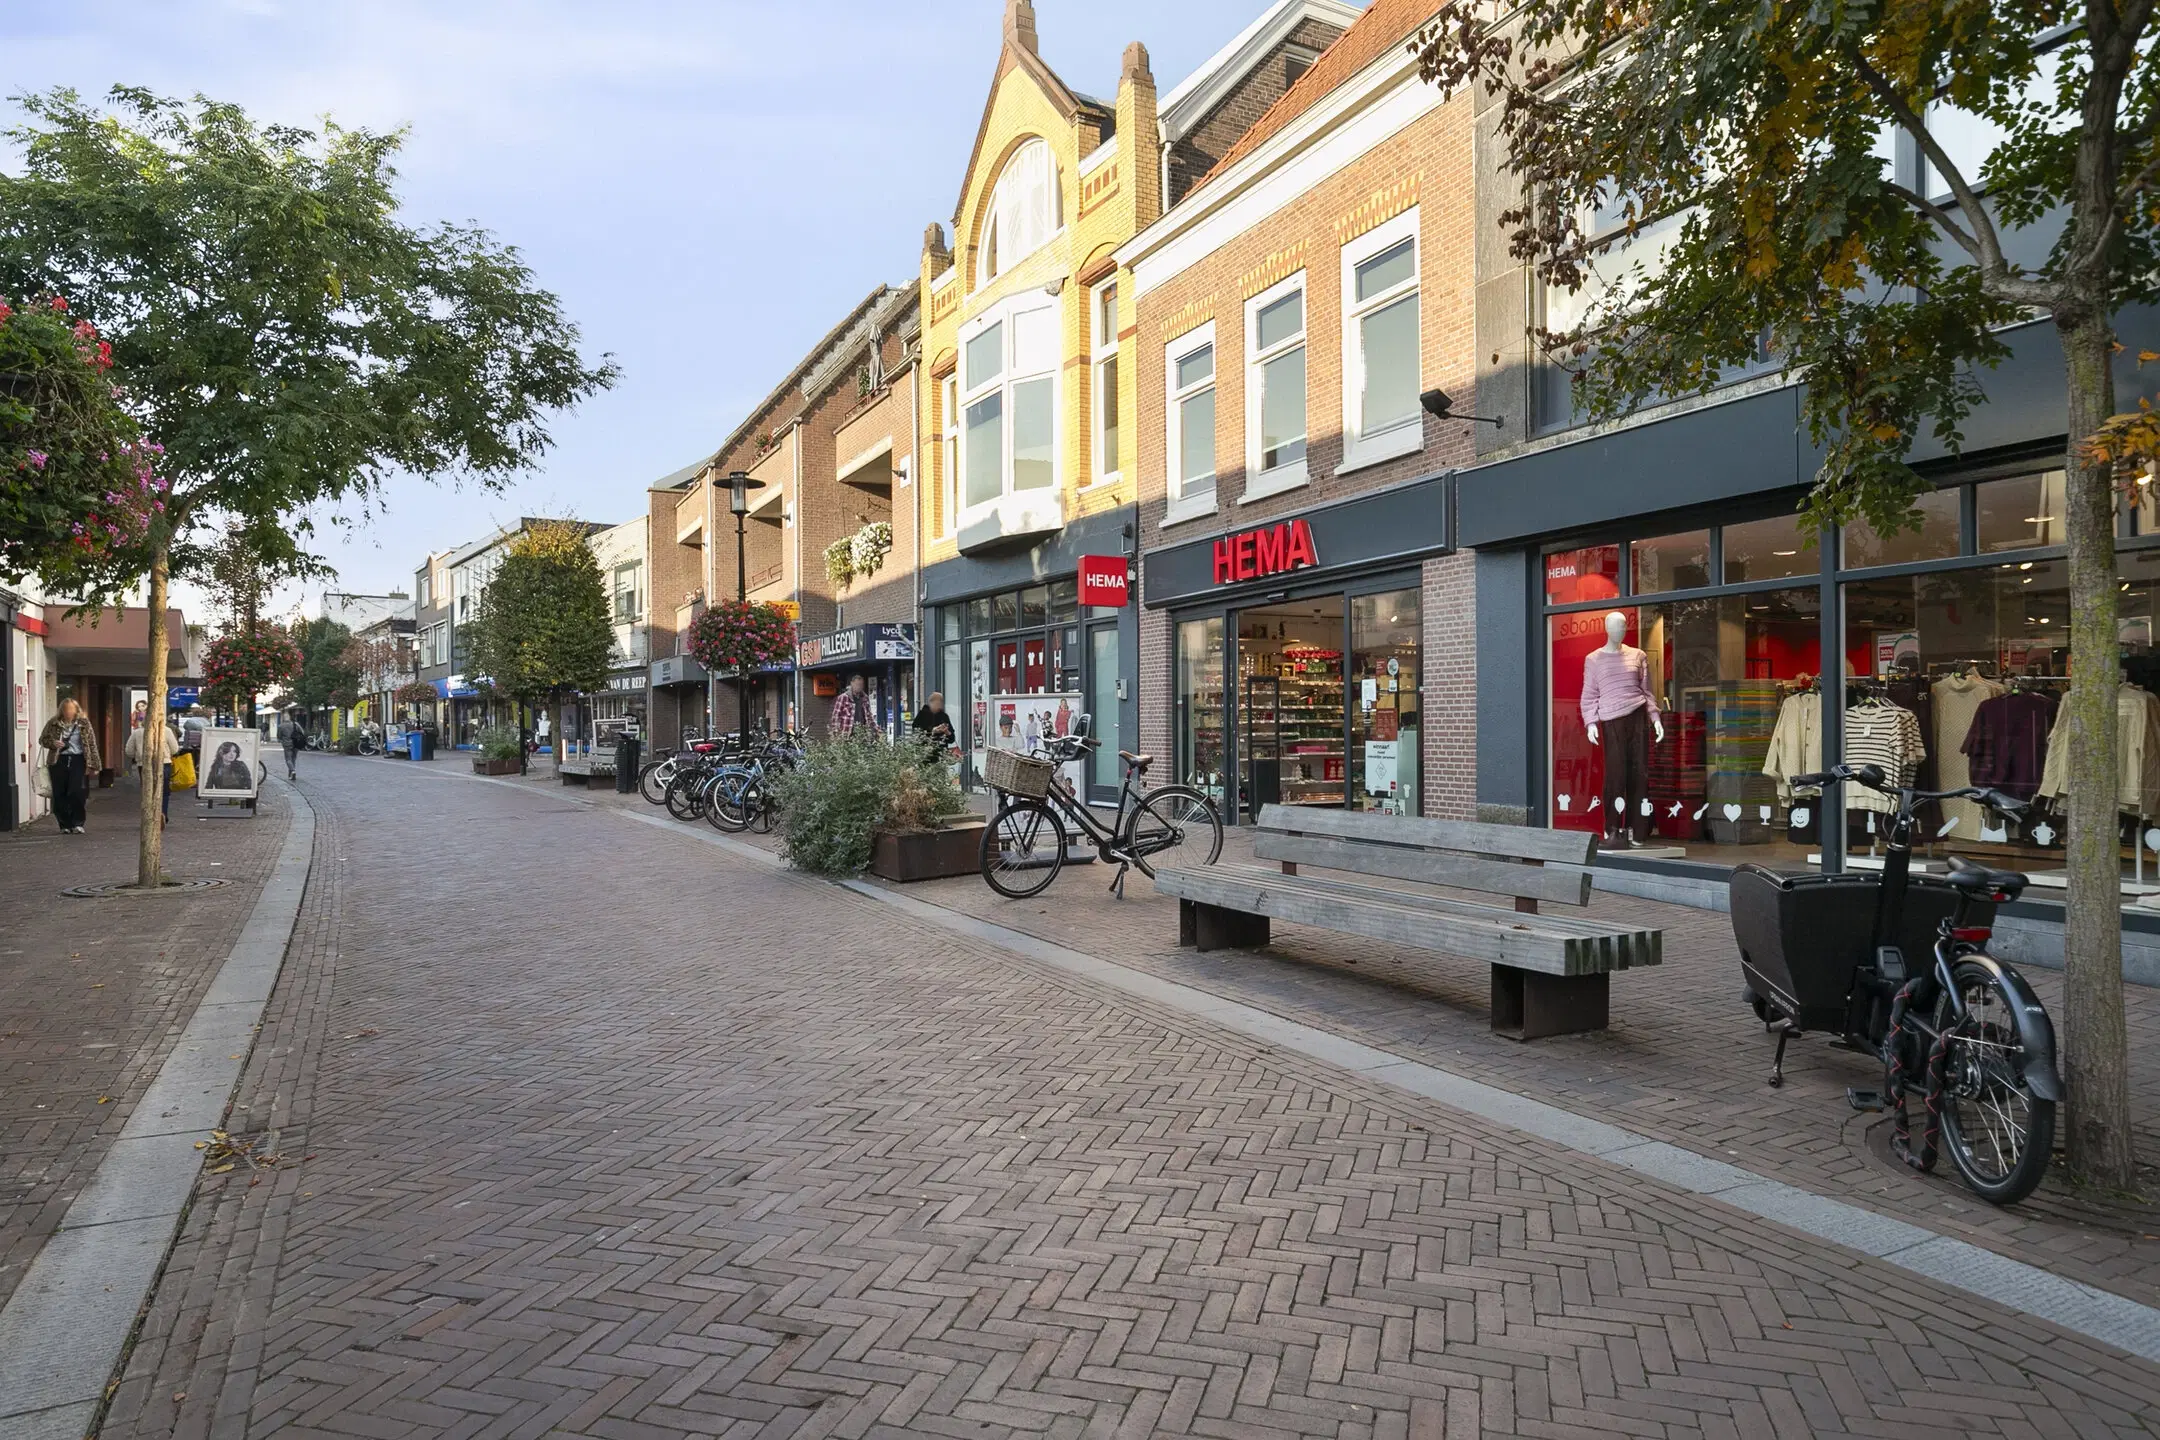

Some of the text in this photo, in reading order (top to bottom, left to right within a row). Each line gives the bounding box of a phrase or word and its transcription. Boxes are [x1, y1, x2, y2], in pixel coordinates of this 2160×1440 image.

[1213, 518, 1319, 585] HEMA
[1549, 565, 1576, 579] HEMA
[1086, 573, 1126, 588] HEMA
[801, 630, 857, 666] GSM HILLEGOM
[622, 677, 631, 690] DE
[632, 676, 647, 689] REEP
